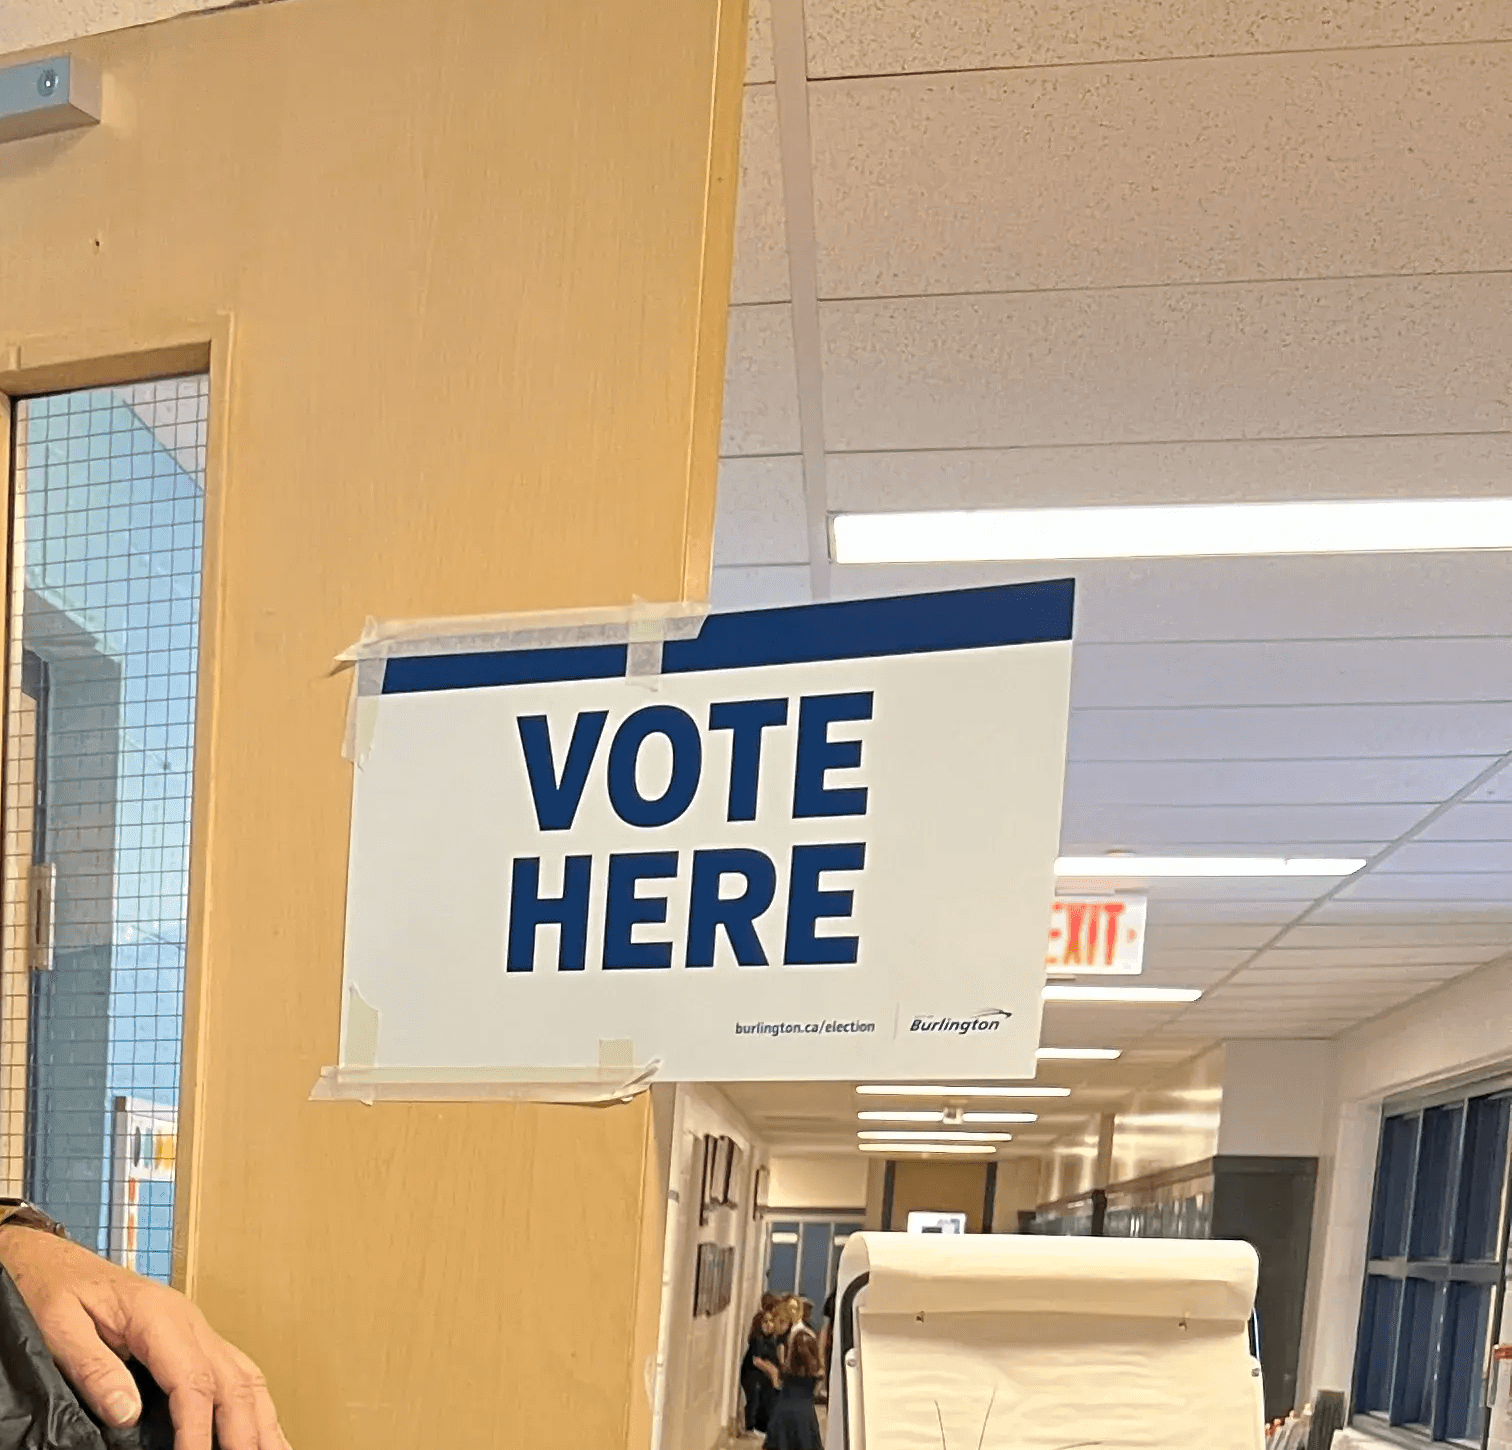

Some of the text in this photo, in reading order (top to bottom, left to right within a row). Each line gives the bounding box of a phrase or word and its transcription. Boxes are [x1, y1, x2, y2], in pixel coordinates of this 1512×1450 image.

[516, 691, 874, 831] VOTE
[506, 841, 867, 973] HERE
[735, 1017, 1000, 1036] burlington.ca/election Burlington
